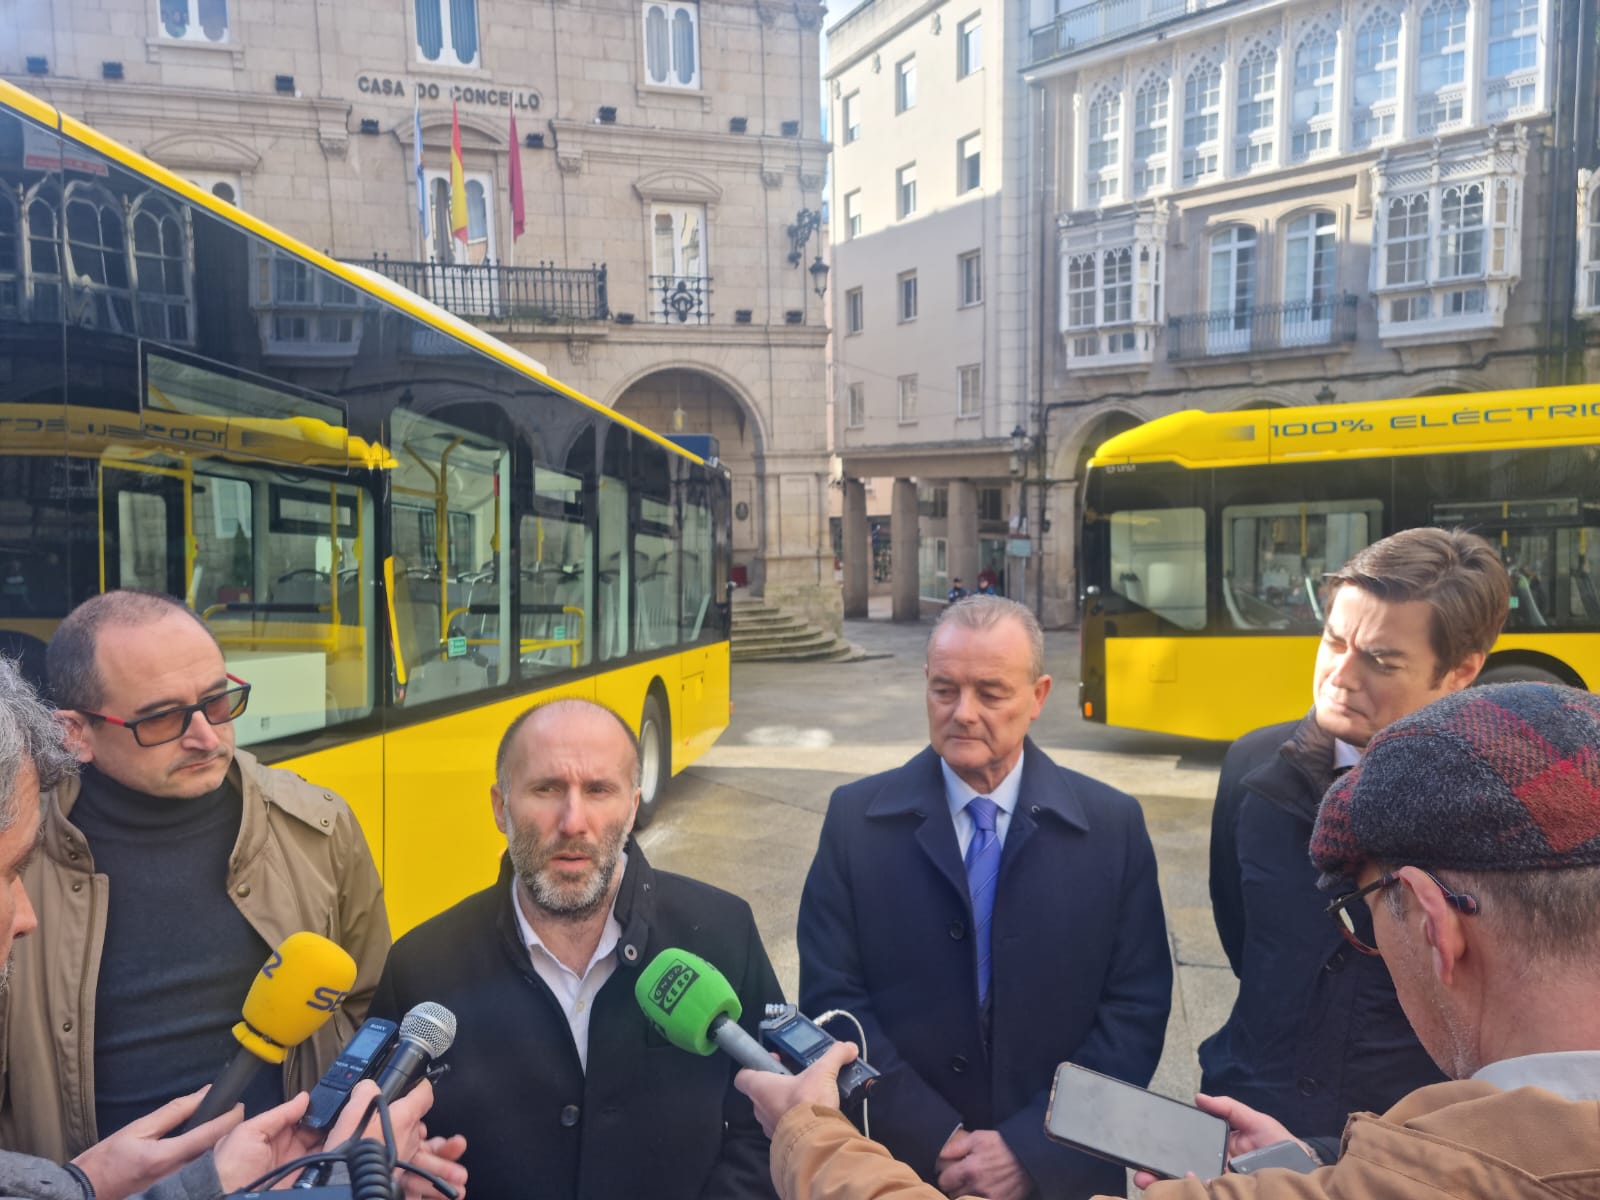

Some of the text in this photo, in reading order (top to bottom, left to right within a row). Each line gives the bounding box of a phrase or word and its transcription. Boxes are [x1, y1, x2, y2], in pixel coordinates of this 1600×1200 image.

[358, 76, 405, 97] CASA
[415, 82, 440, 99] DO
[1271, 418, 1374, 438] 100%
[665, 972, 691, 1003] CERO
